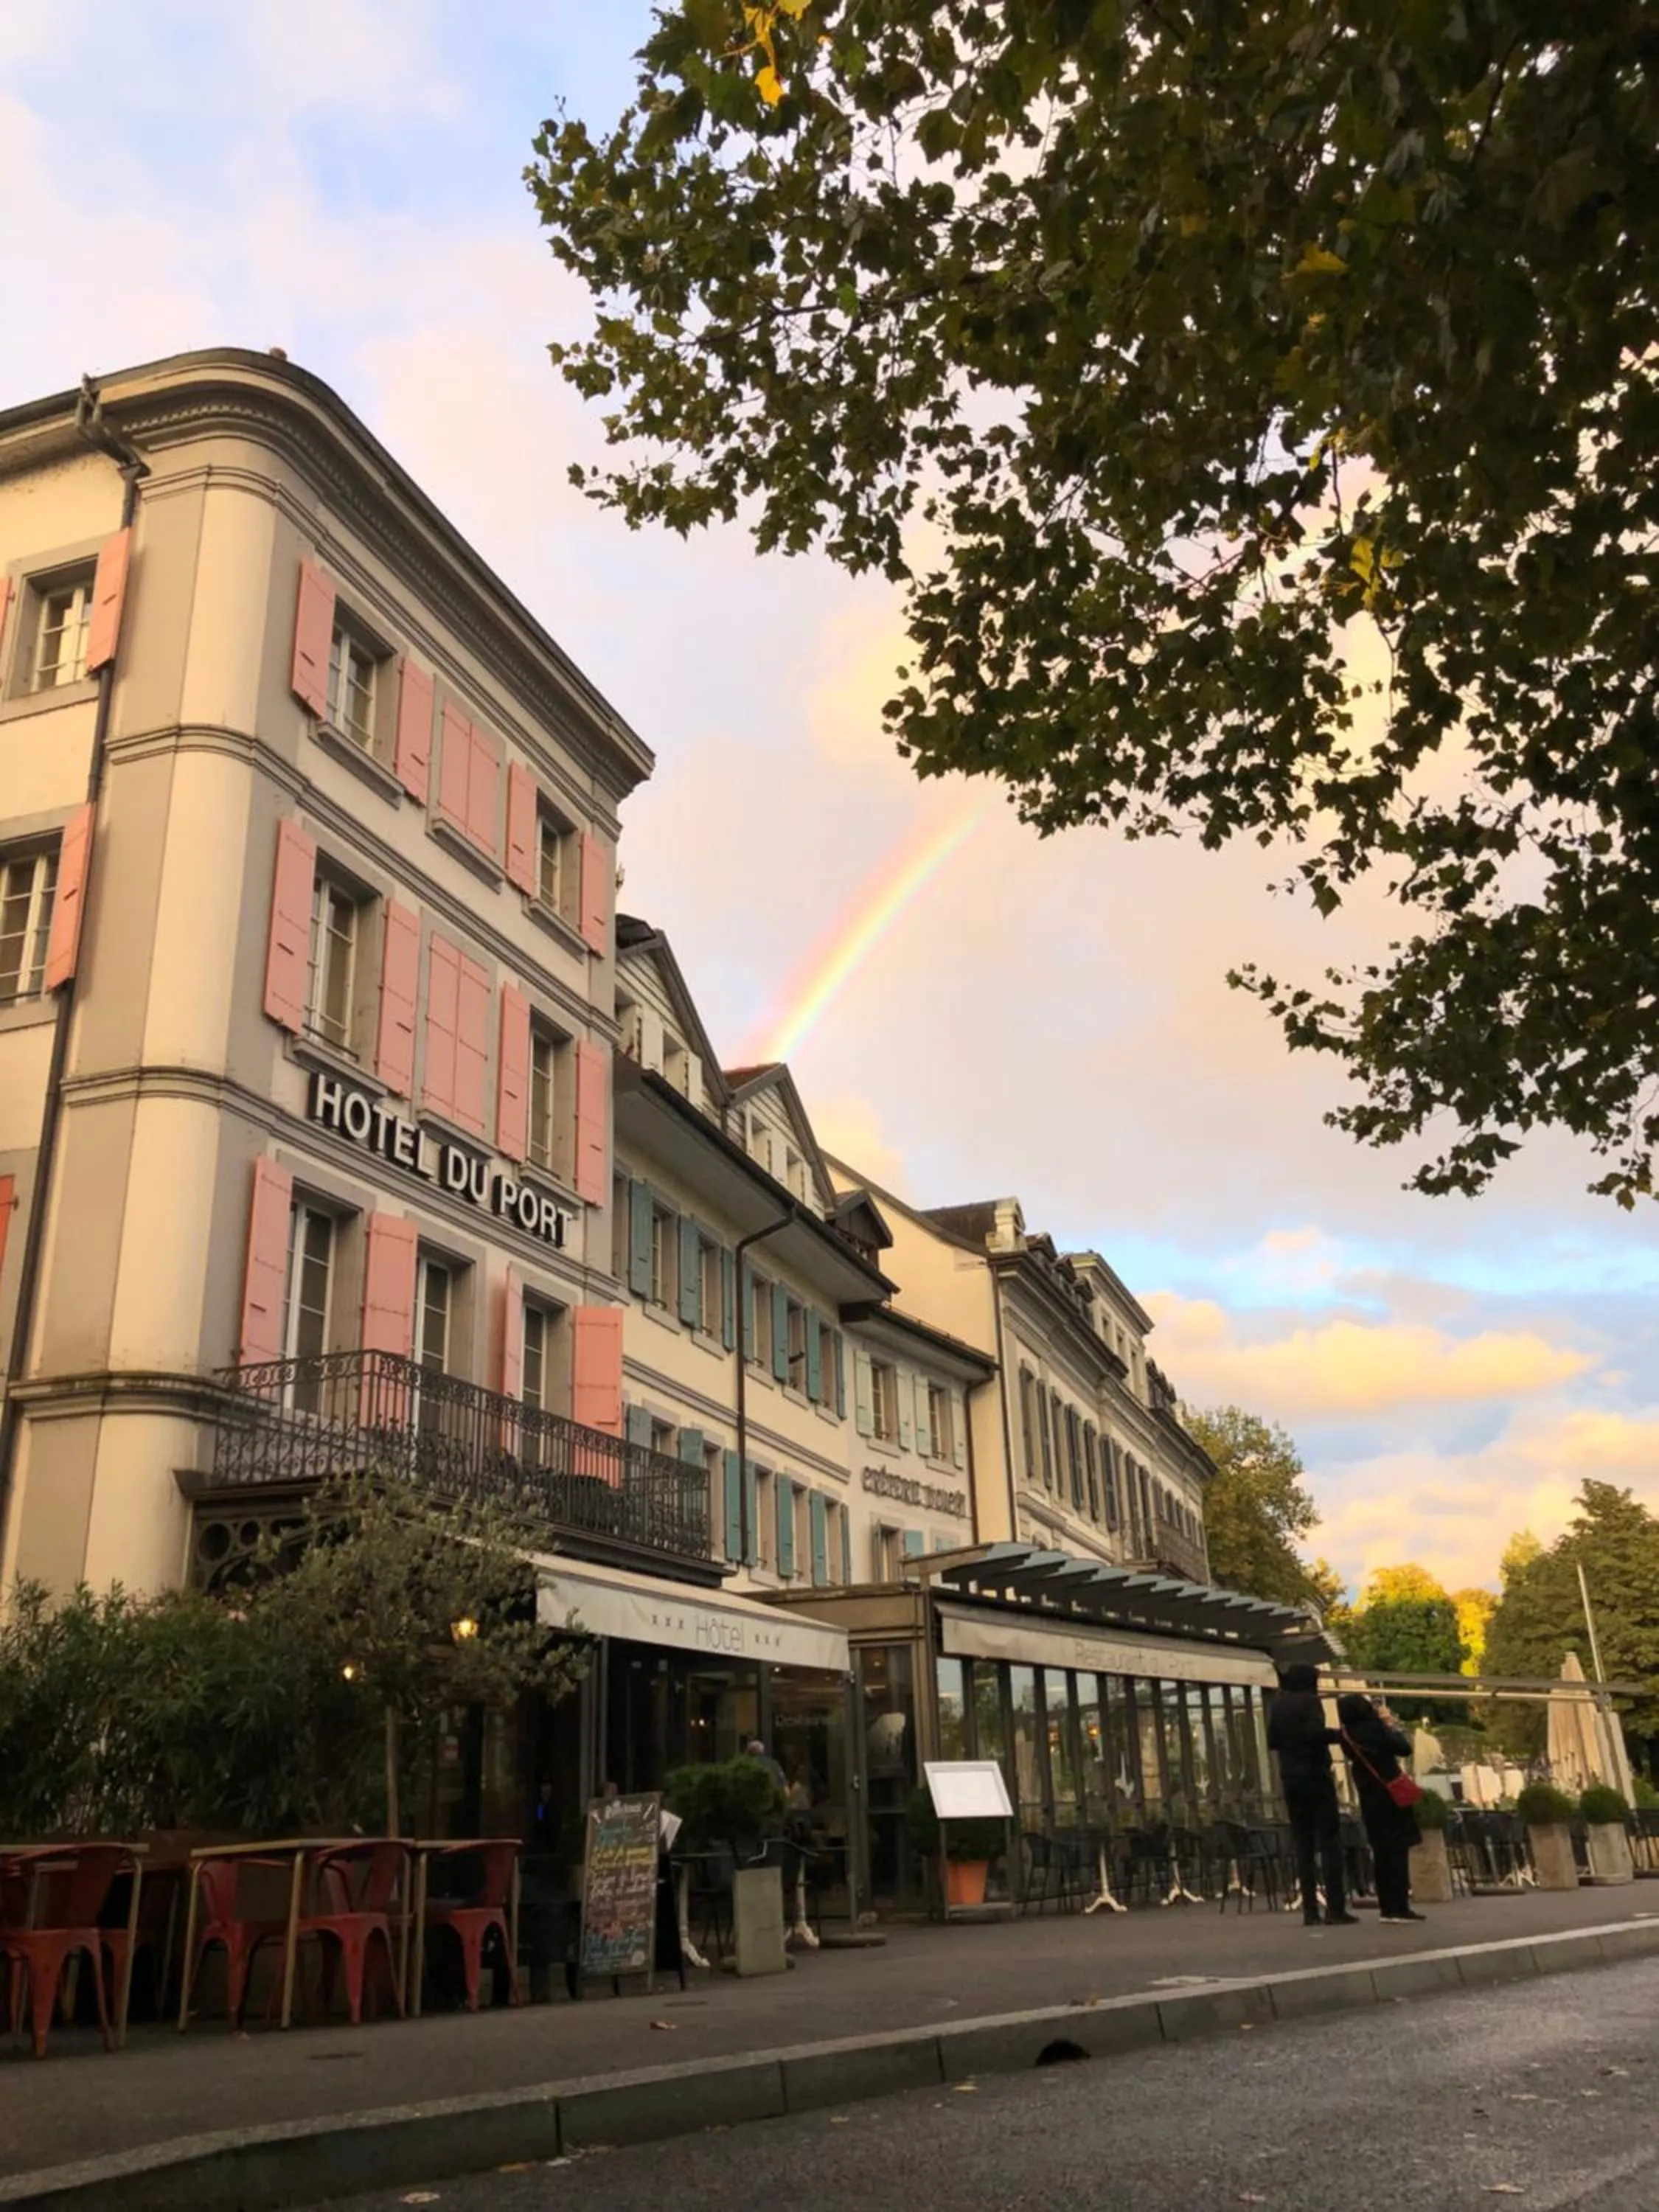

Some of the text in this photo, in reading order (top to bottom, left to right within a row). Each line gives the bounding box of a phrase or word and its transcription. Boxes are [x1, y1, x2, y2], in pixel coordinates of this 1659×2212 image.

[313, 1073, 574, 1247] HOTEL DU PORT
[695, 1613, 745, 1652] Hôtel
